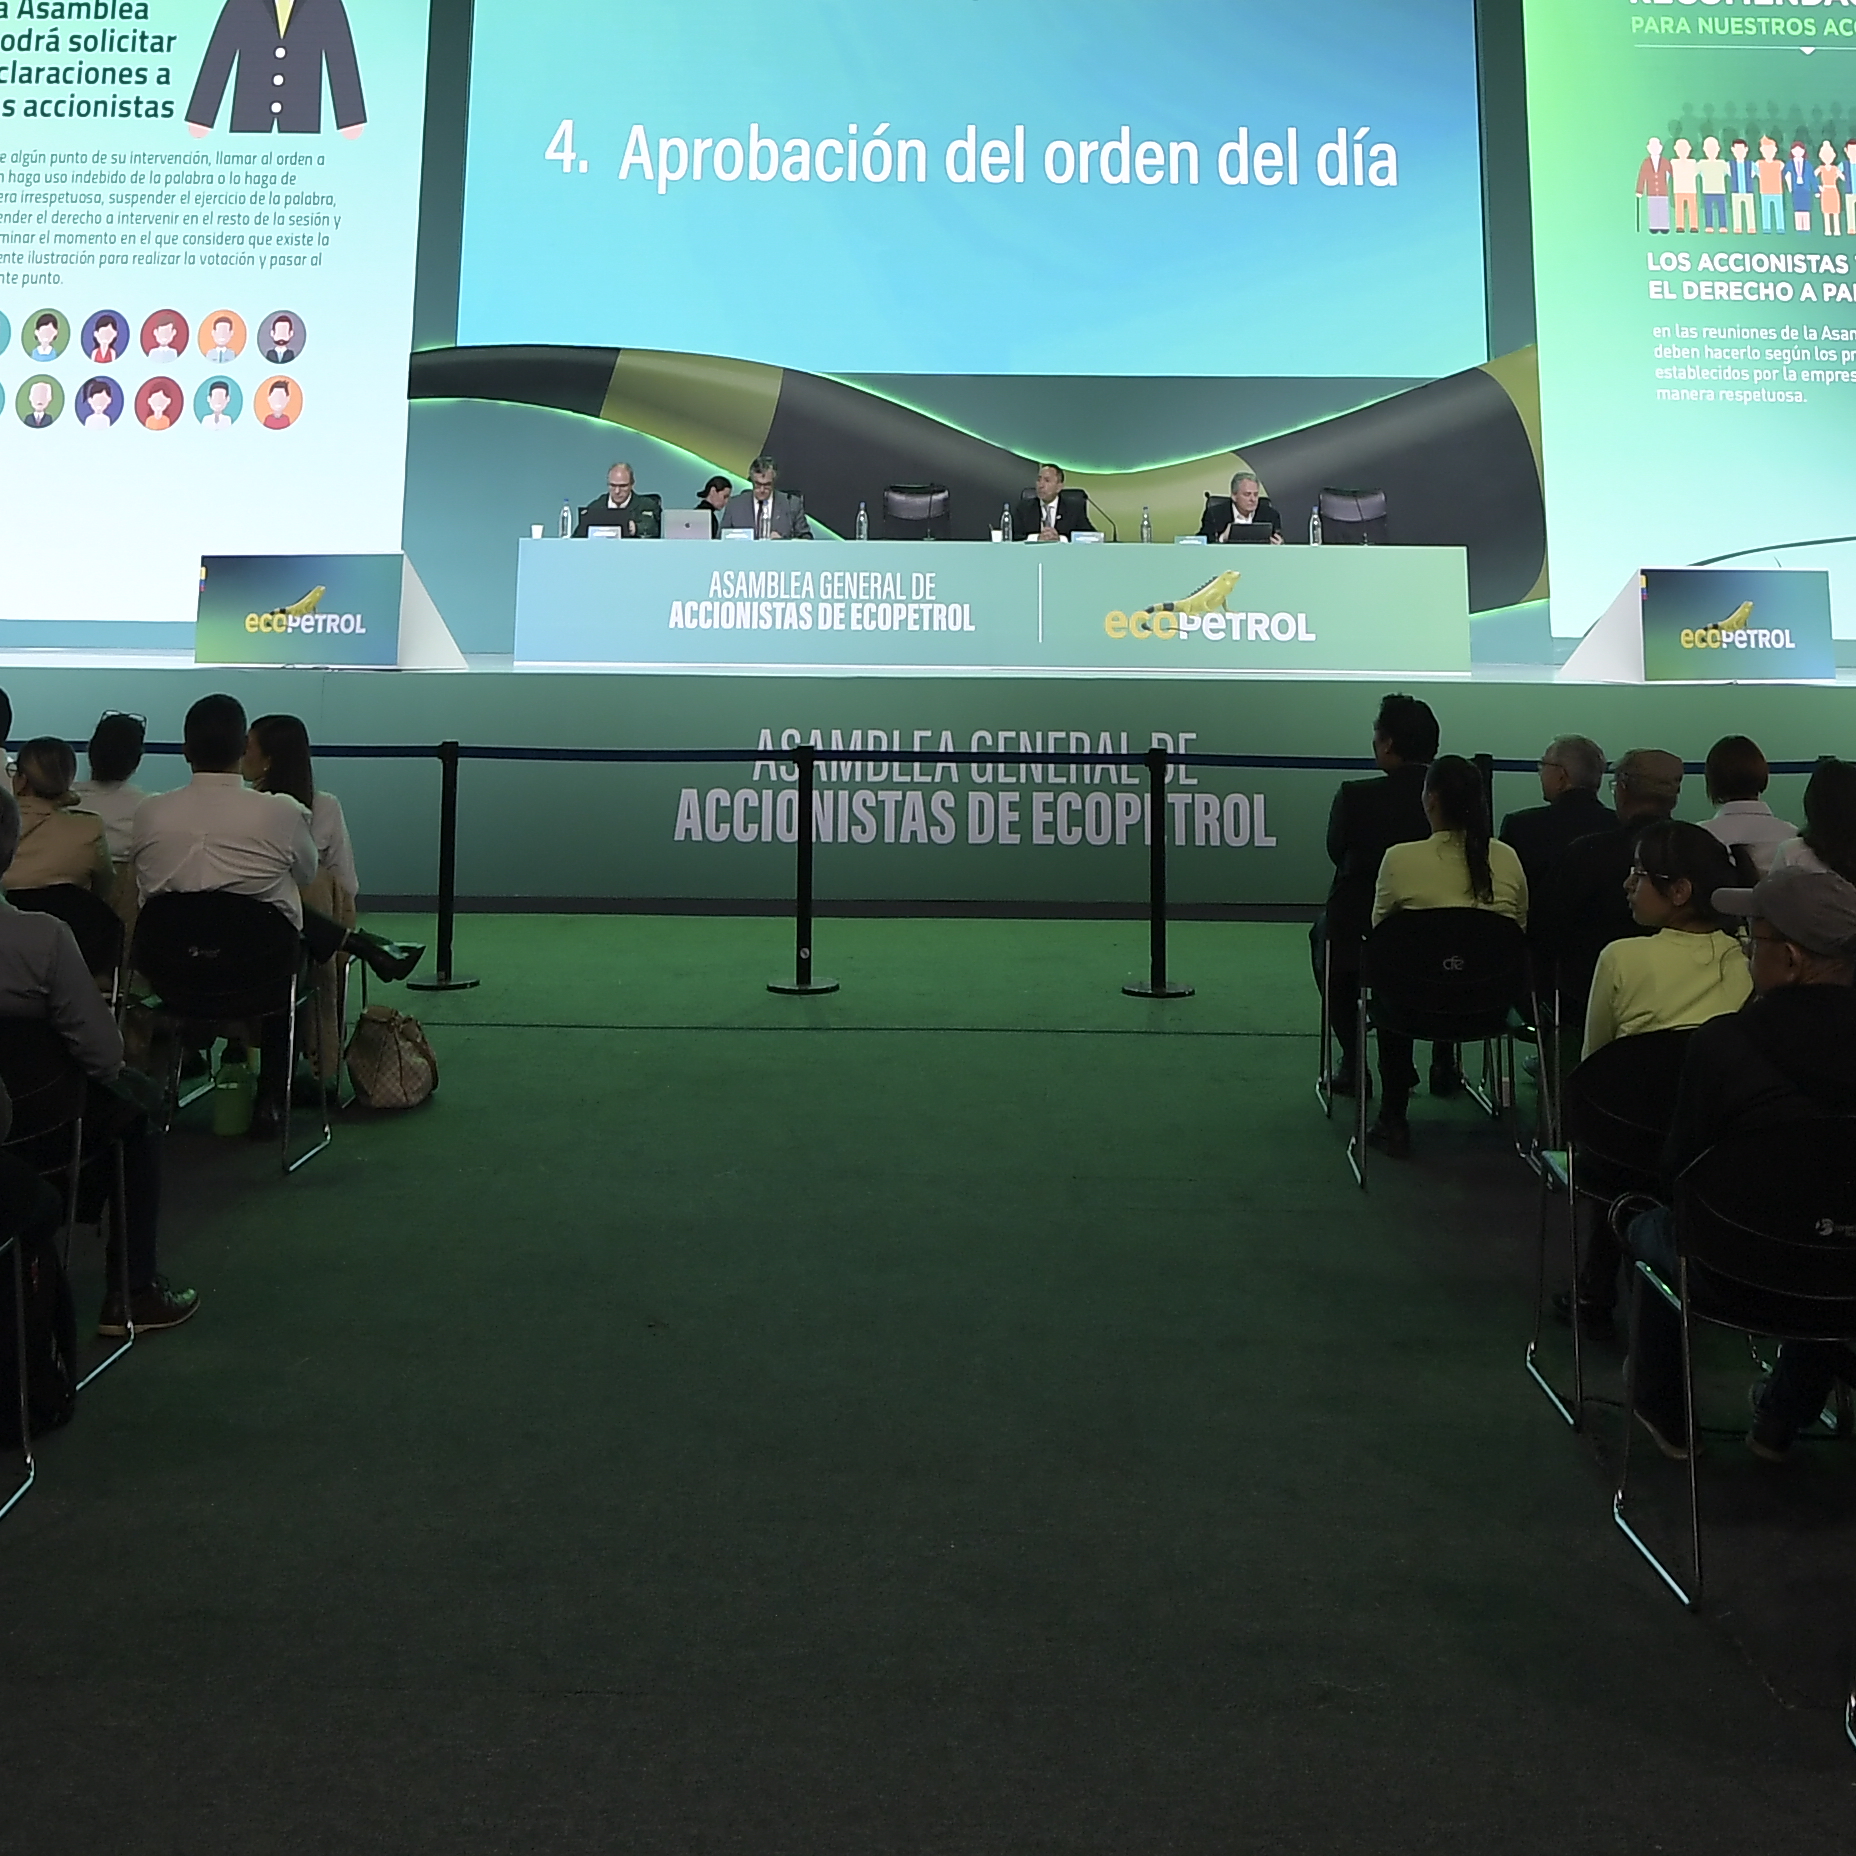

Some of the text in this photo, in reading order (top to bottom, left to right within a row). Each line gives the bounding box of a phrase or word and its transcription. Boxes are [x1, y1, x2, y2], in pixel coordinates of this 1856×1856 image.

[1632, 17, 1691, 34] PARA
[1698, 17, 1816, 36] NUESTROS
[68, 28, 177, 53] solicitar
[156, 68, 170, 85] a
[23, 93, 174, 118] accionistas
[11, 149, 46, 167] algún
[50, 152, 87, 167] punto
[92, 150, 107, 164] de
[111, 154, 126, 164] su
[130, 150, 211, 166] intervención,
[216, 151, 257, 165] llamar
[261, 151, 272, 165] al
[277, 151, 312, 165] orden
[317, 155, 325, 165] a
[545, 119, 1397, 194] 4. Aprobación del orden del día
[1648, 252, 1691, 271] LOS
[1698, 253, 1848, 274] ACCIONISTAS
[1649, 281, 1677, 299] EL
[1683, 281, 1793, 301] DERECHO
[1800, 283, 1817, 301] A
[1653, 327, 1670, 337] en
[1676, 324, 1698, 338] las
[1703, 324, 1777, 339] reuniones
[1781, 325, 1799, 340] de
[1803, 325, 1817, 340] la
[1655, 344, 1699, 358] deben
[1705, 345, 1760, 360] hacerlo
[1765, 345, 1810, 364] según
[1815, 346, 1837, 361] los
[1656, 365, 1749, 380] establecidos
[1754, 369, 1779, 384] por
[1783, 366, 1797, 381] la
[1657, 388, 1808, 405] manera respetuosa.
[709, 571, 936, 600] ASAMBLEA GENERAL DE
[669, 601, 975, 631] ACCIONISTAS DE ECOPETROL
[673, 787, 956, 844] ACCIONISTAS
[967, 790, 1022, 845] DE
